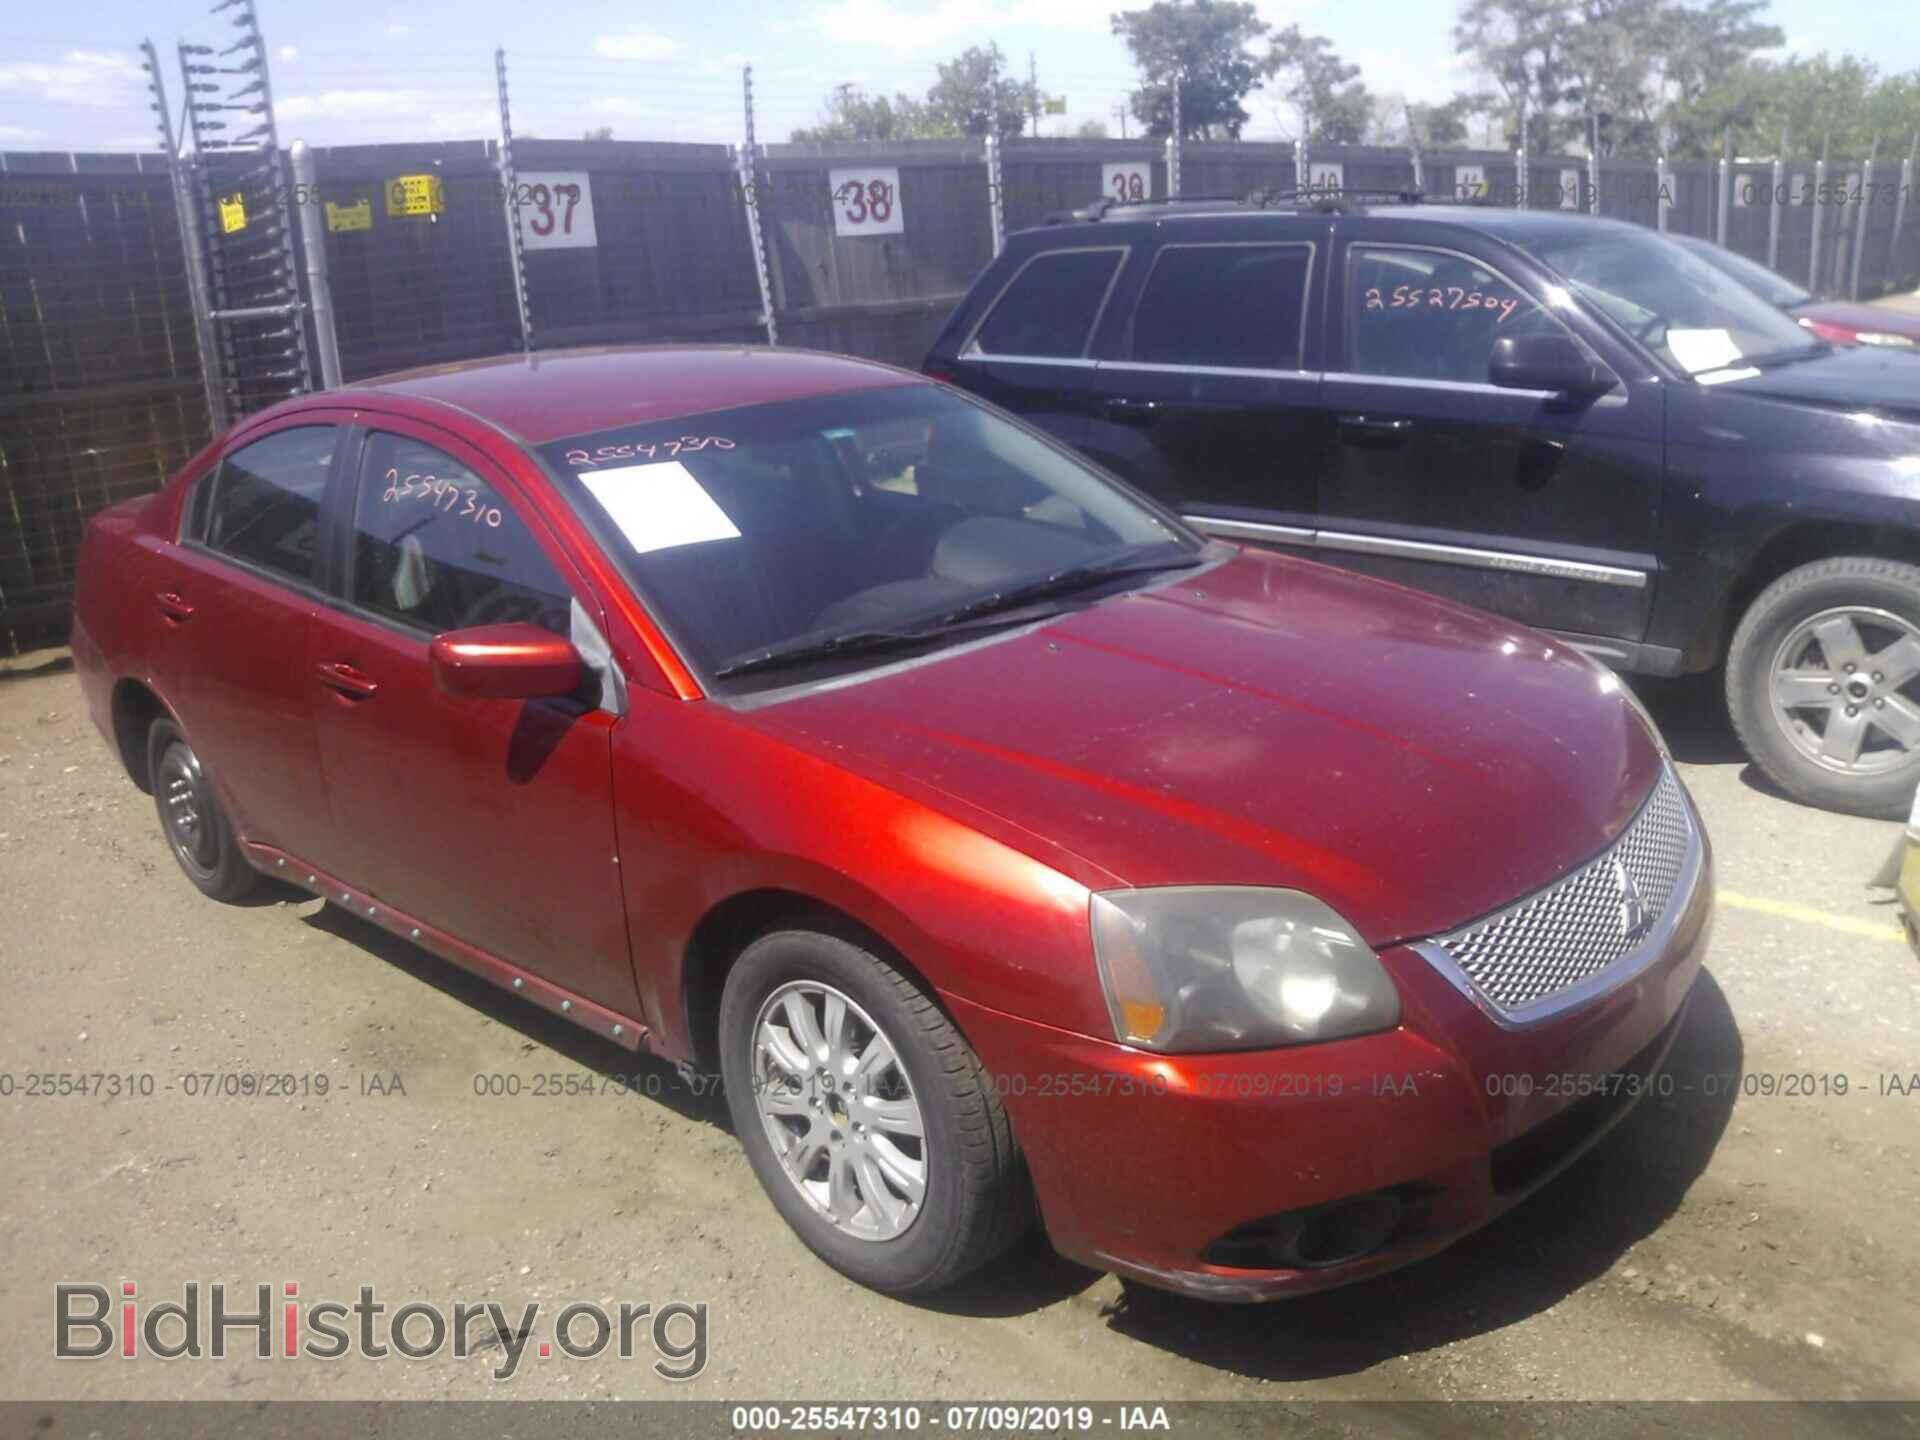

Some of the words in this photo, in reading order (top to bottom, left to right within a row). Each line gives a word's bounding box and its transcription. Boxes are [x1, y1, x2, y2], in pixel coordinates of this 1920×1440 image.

[530, 183, 578, 236] 37
[846, 179, 891, 224] 38
[383, 467, 502, 528] 25547310
